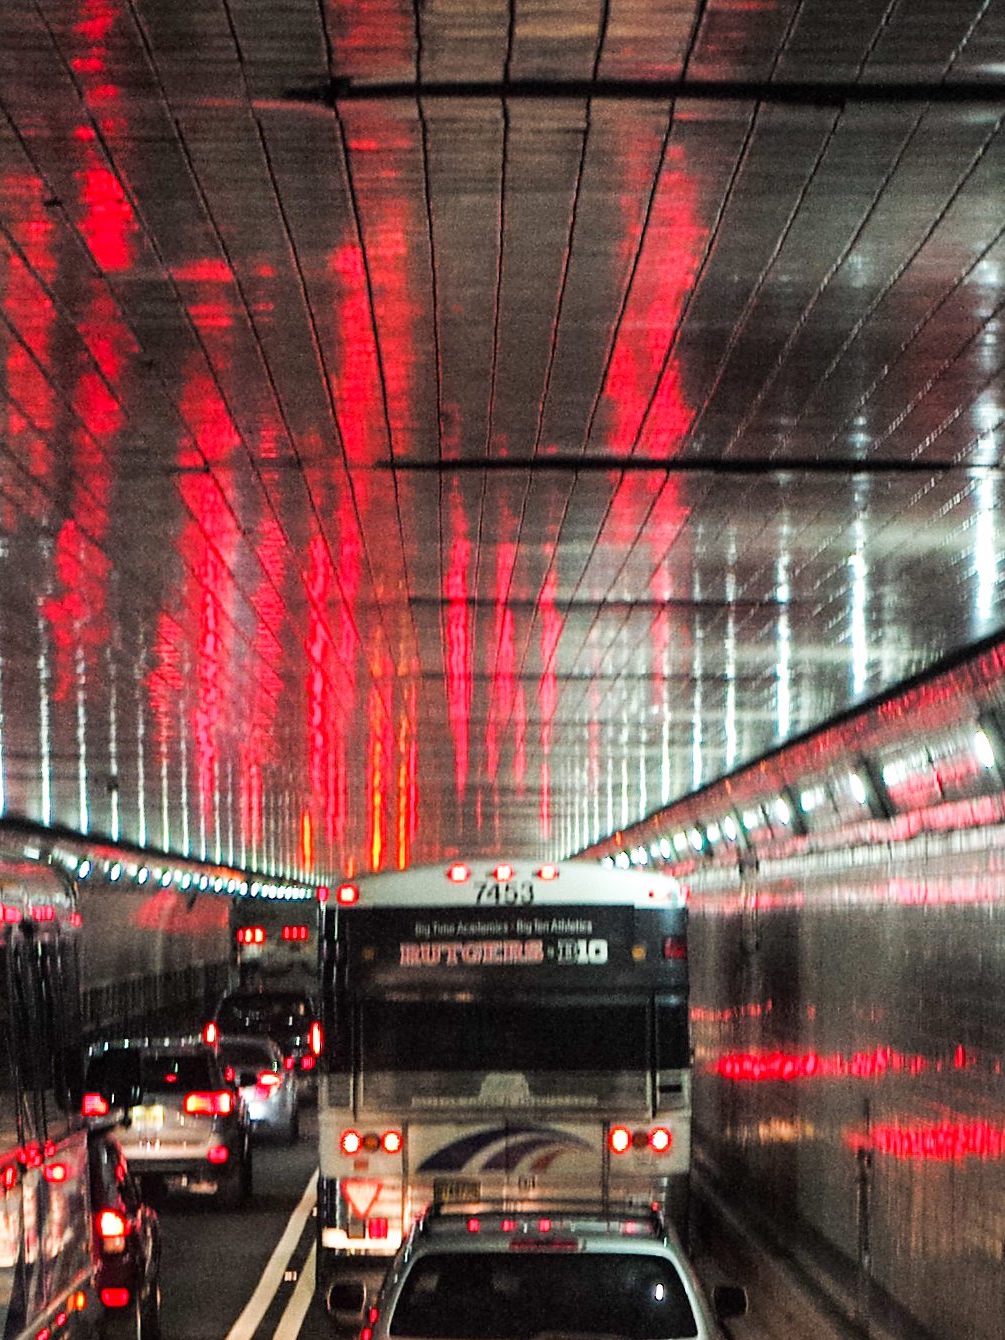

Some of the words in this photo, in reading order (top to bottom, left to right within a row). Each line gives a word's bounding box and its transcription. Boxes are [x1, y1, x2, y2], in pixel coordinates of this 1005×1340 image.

[474, 881, 535, 905] 7453
[551, 917, 593, 934] Athletics
[400, 939, 544, 965] RUTGERS
